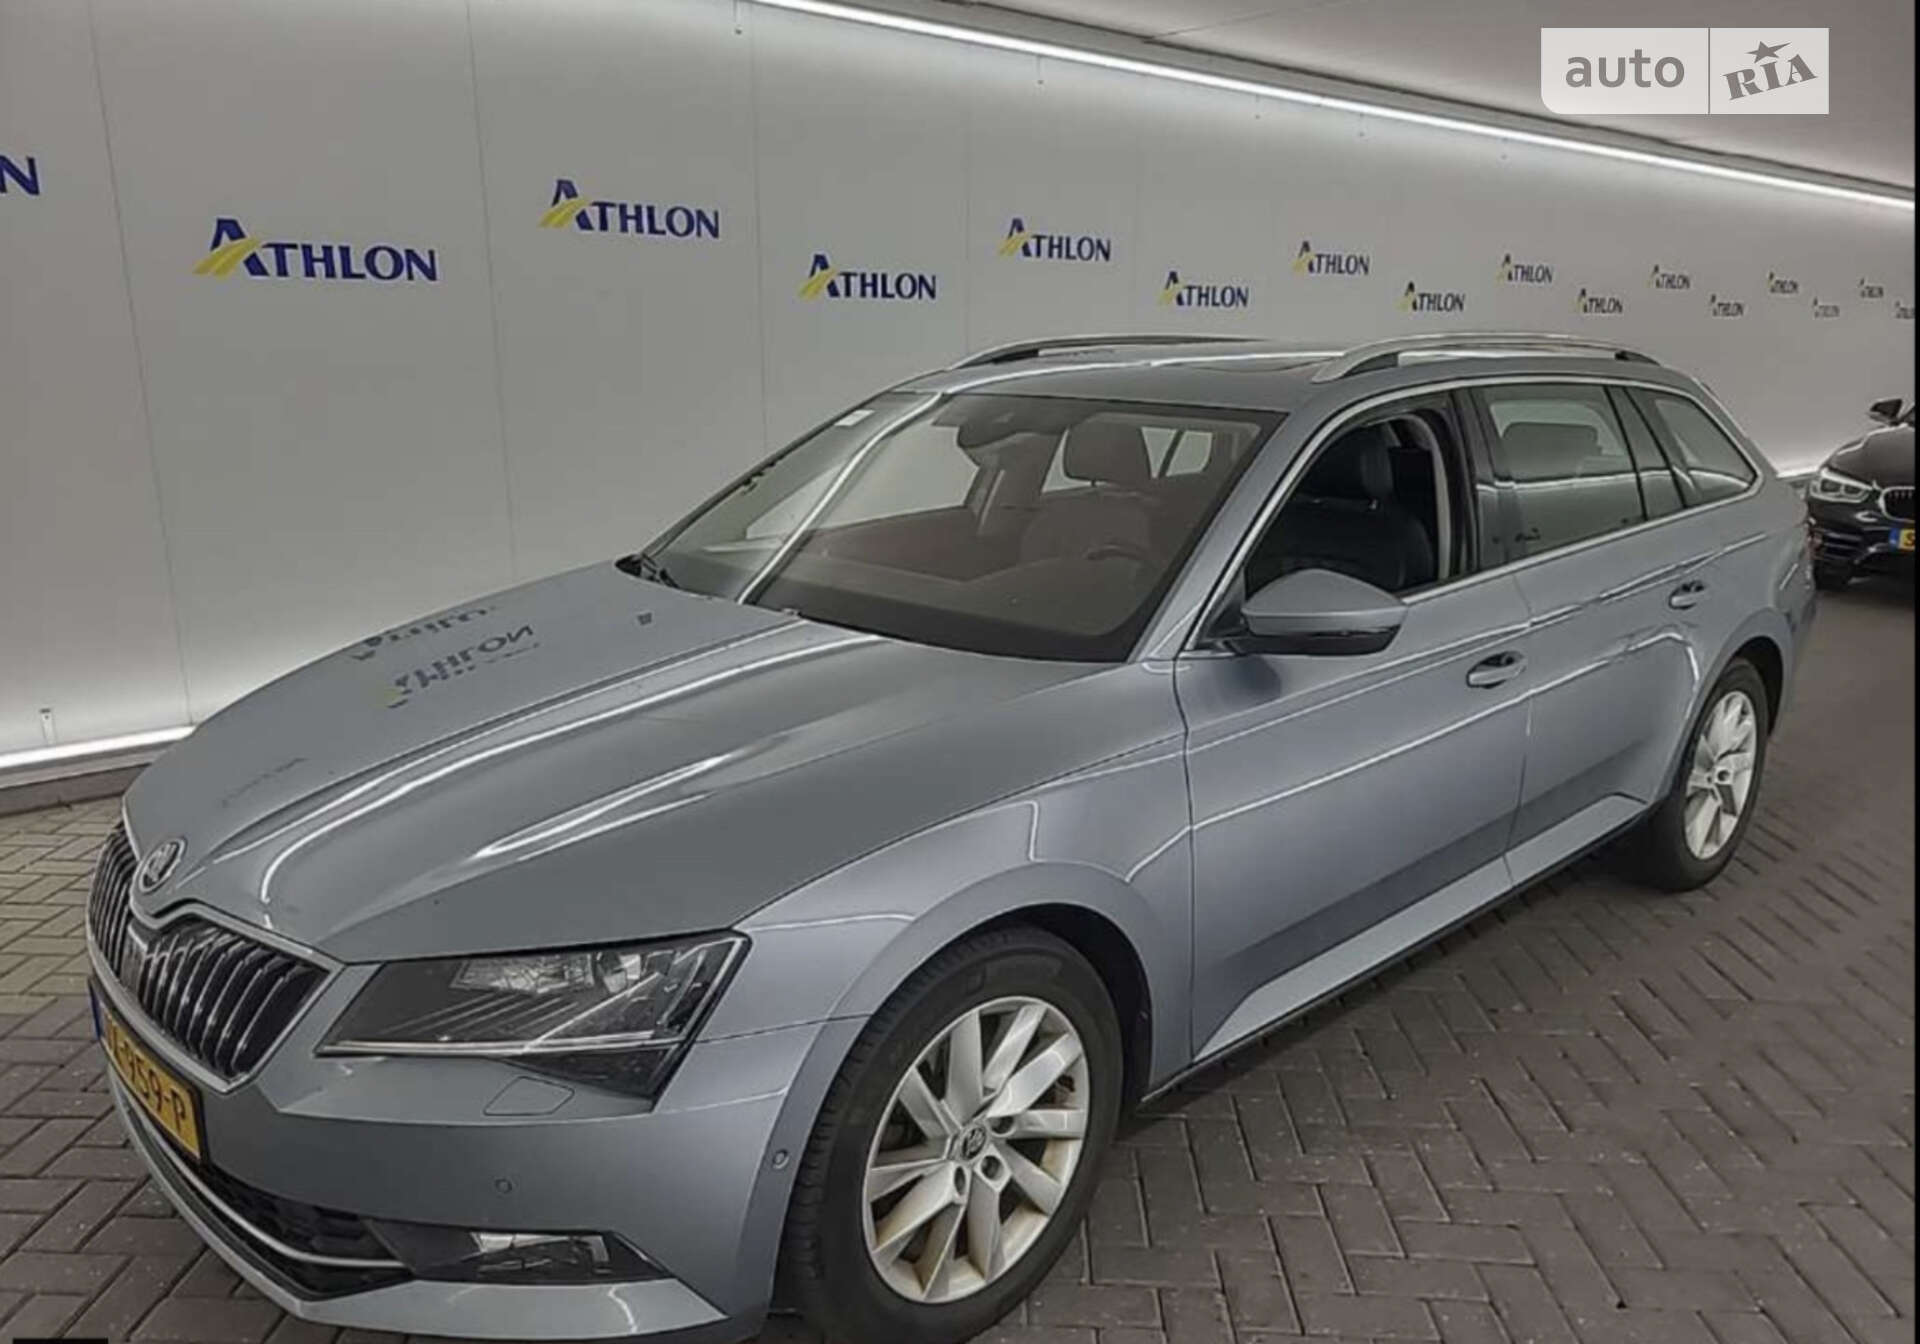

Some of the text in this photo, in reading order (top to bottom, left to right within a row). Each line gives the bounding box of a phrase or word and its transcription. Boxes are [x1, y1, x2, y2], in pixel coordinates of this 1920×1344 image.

[539, 179, 720, 239] ATHLON
[193, 217, 438, 281] ATHLON
[1000, 218, 1111, 262] ATHLON
[800, 254, 936, 299] ATHLON
[1294, 241, 1370, 276] ATHLON
[1500, 254, 1553, 283] ATHLON
[1160, 271, 1248, 307] ATHLON
[1401, 281, 1465, 312] ATHLON
[1573, 288, 1623, 314] ATHLON
